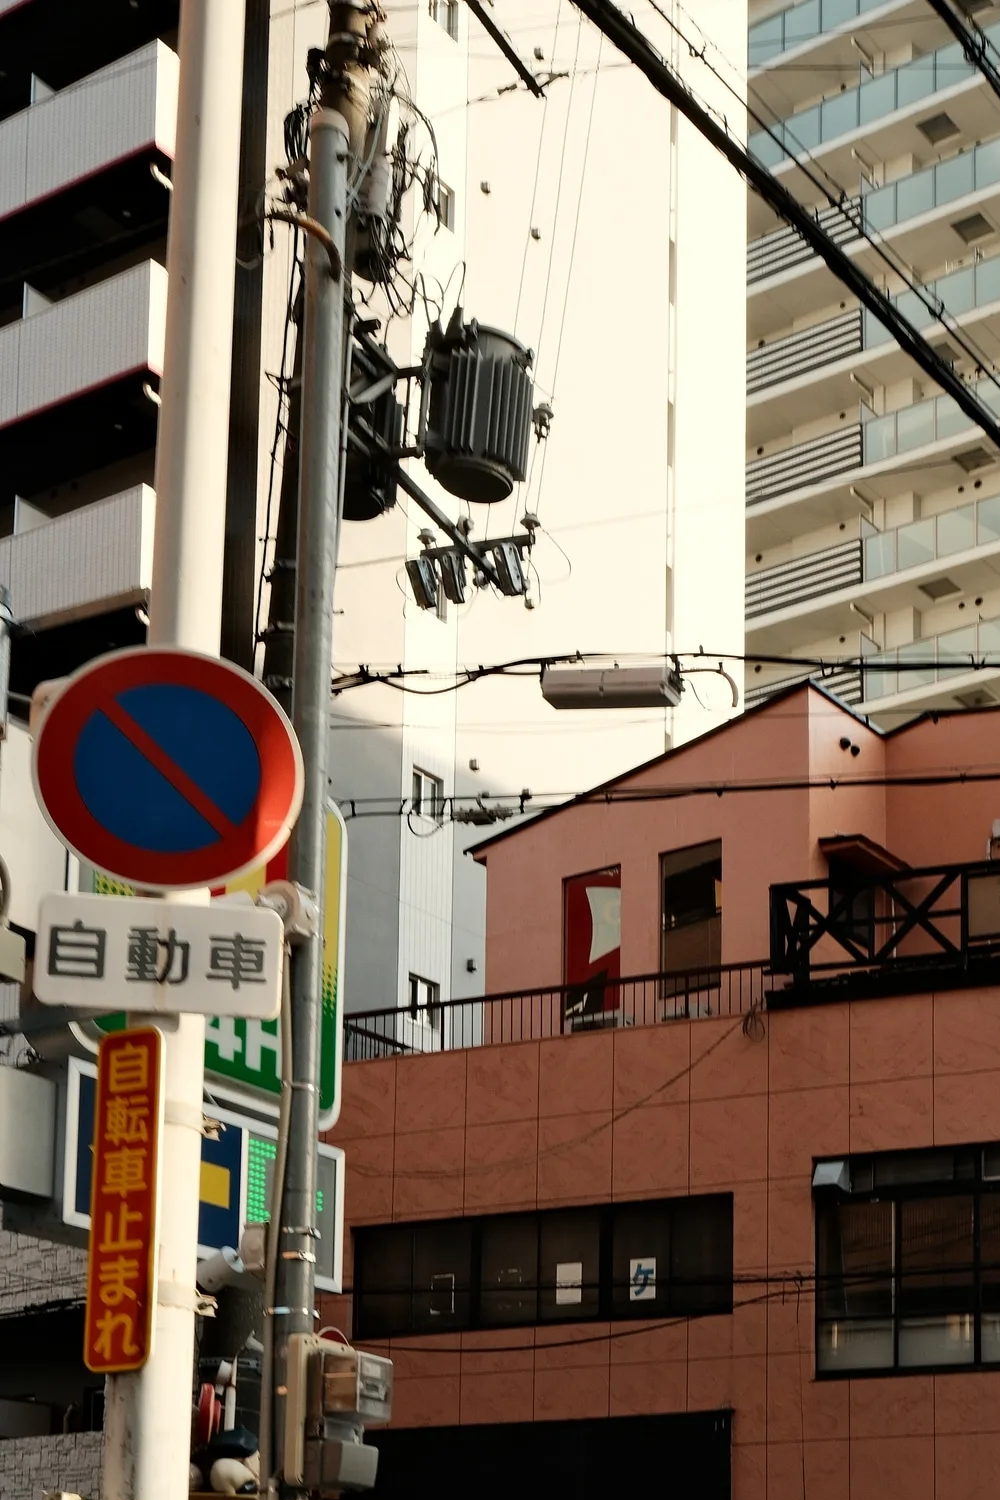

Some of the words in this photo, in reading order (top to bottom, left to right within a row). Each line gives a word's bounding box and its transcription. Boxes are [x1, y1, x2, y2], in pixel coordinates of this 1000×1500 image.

[49, 919, 267, 990] 自動車
[94, 1042, 151, 1360] 自転車止まれ
[632, 1263, 654, 1297] ケ
